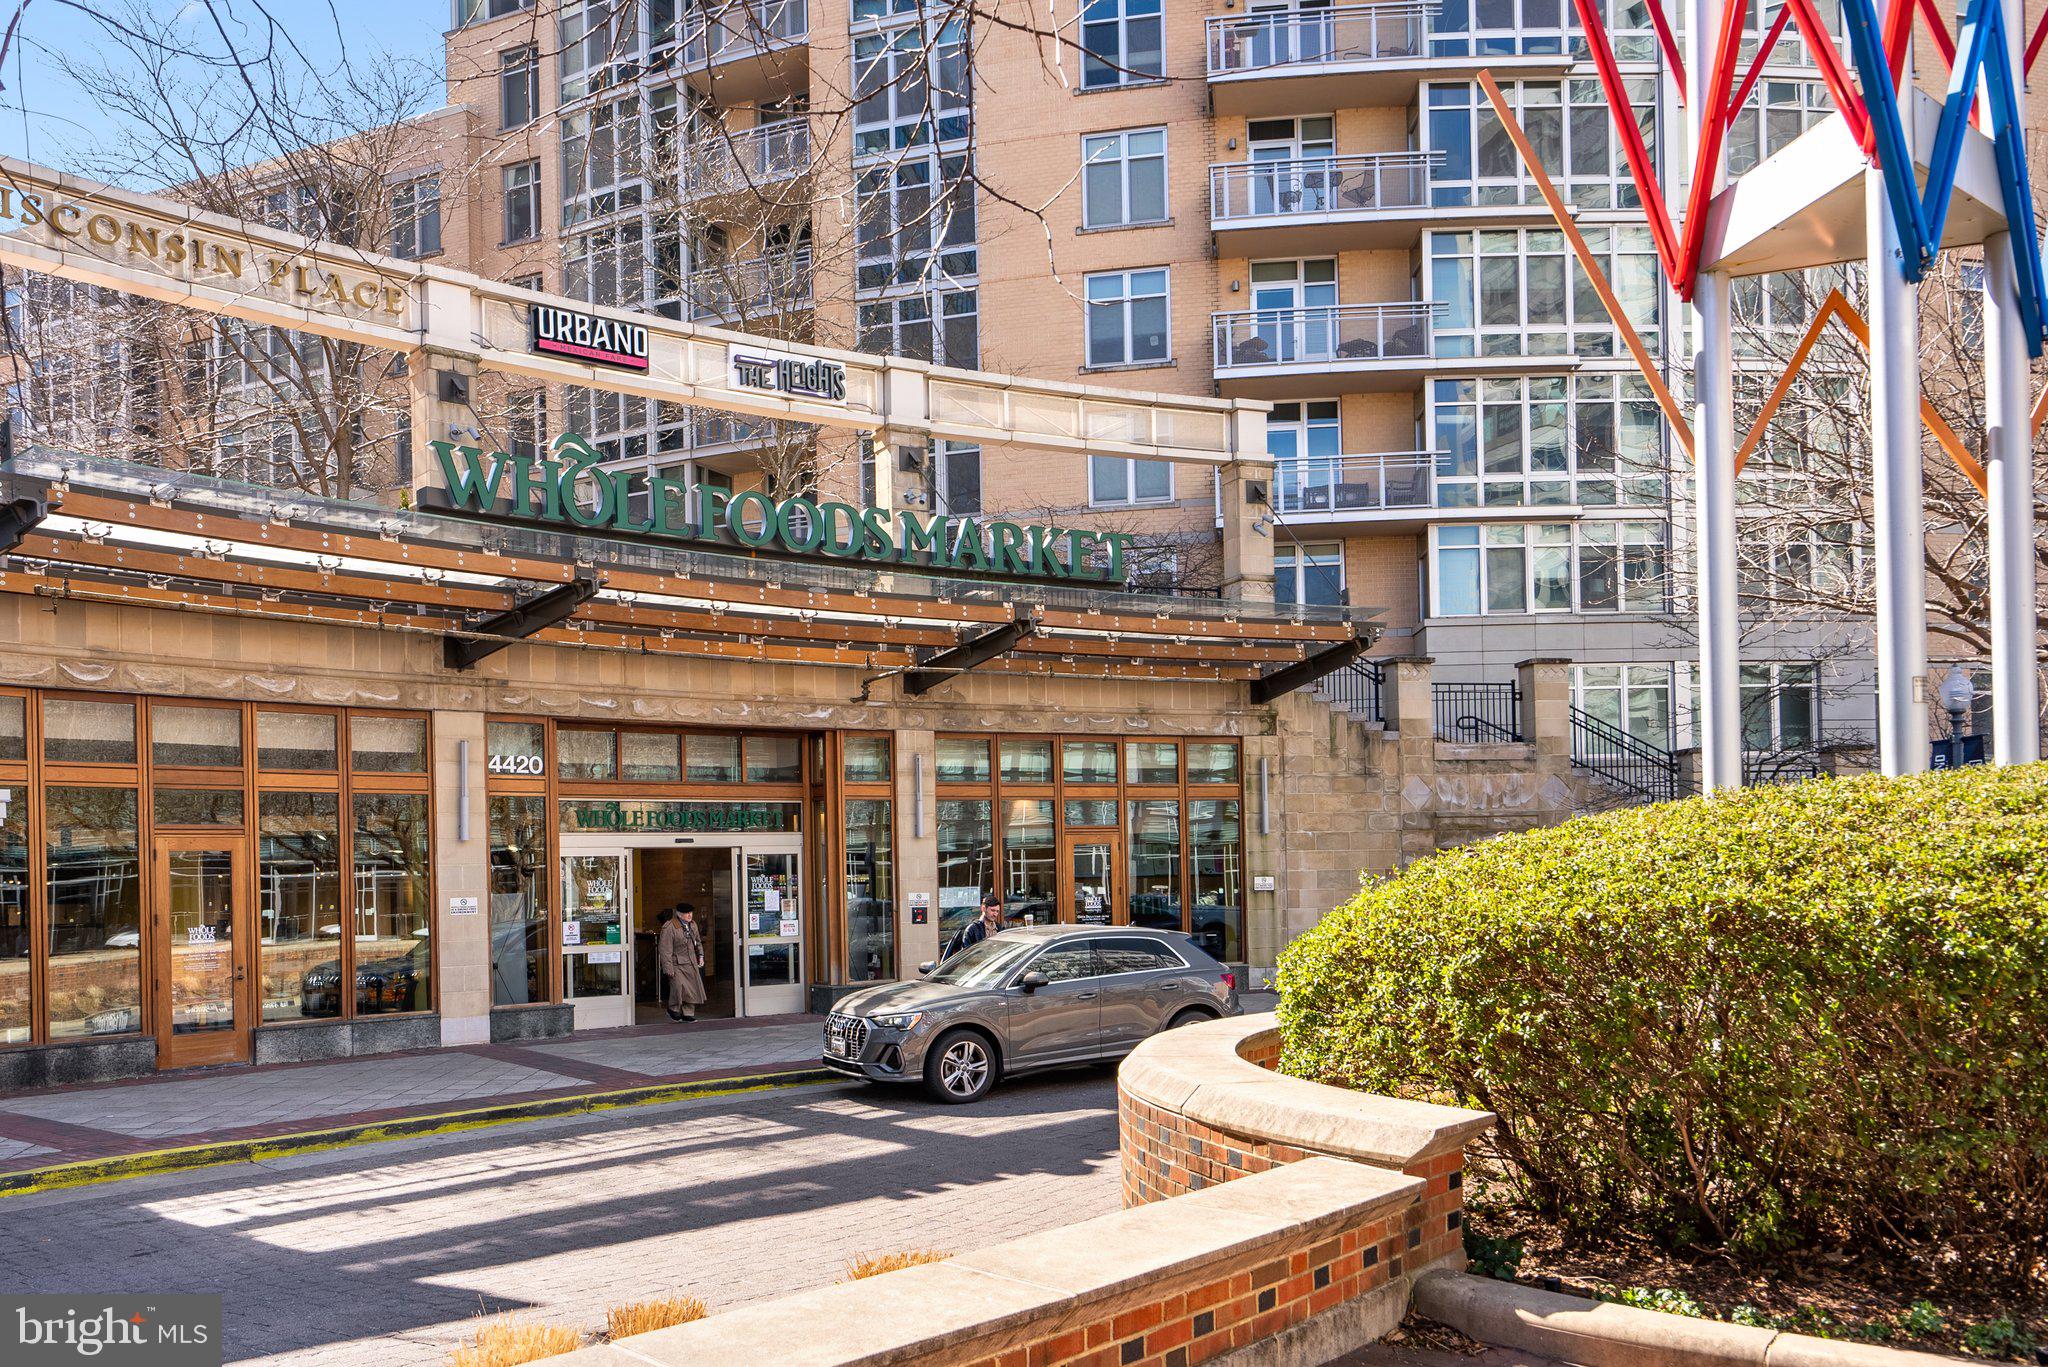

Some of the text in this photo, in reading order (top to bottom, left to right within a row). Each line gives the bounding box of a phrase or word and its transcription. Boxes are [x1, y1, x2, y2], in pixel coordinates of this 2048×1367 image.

[267, 258, 405, 315] PLACE
[538, 306, 648, 357] URBANO
[560, 344, 628, 363] MEXICAN FARE
[734, 359, 846, 400] THE HEIGHTS
[426, 433, 1135, 583] WHOLE FOODS MARKET
[488, 754, 543, 774] 4420
[576, 802, 784, 828] WHOLE FOODS MARKET
[587, 879, 613, 887] WHOLE
[751, 875, 773, 883] WHOLE
[188, 925, 216, 934] WHOLE
[190, 933, 215, 941] FOODS
